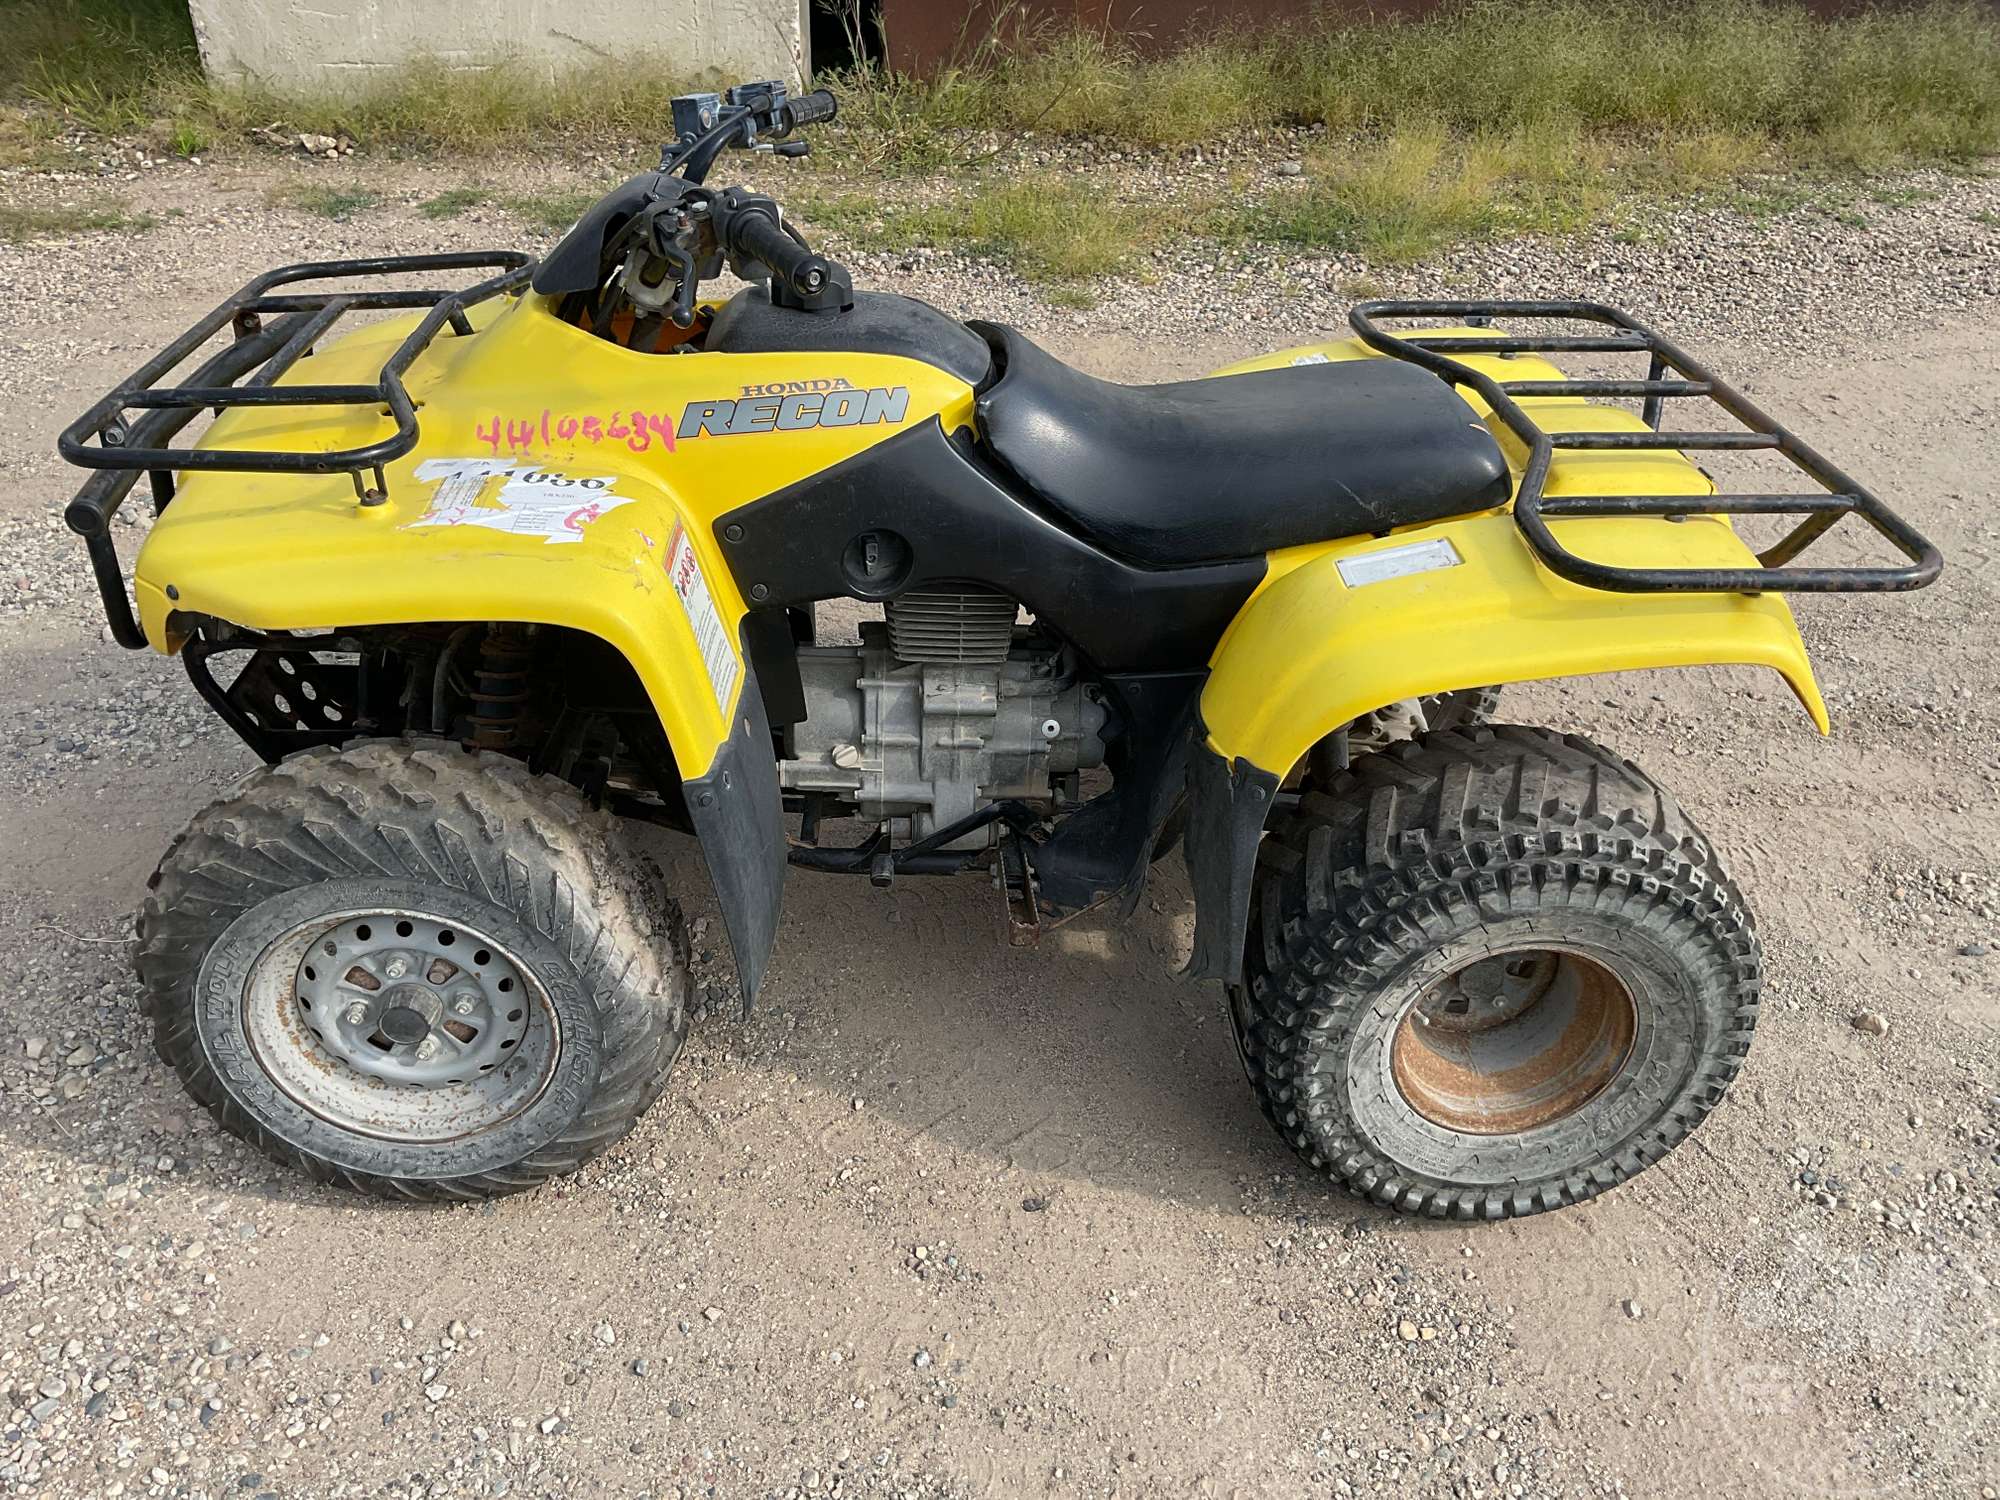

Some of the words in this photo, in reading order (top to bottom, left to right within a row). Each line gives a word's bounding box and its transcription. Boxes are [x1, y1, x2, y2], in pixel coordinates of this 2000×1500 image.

[676, 386, 909, 440] RECON
[742, 376, 854, 397] HONDA
[206, 935, 242, 1020] WOLF
[211, 1032, 281, 1119] TRAIL
